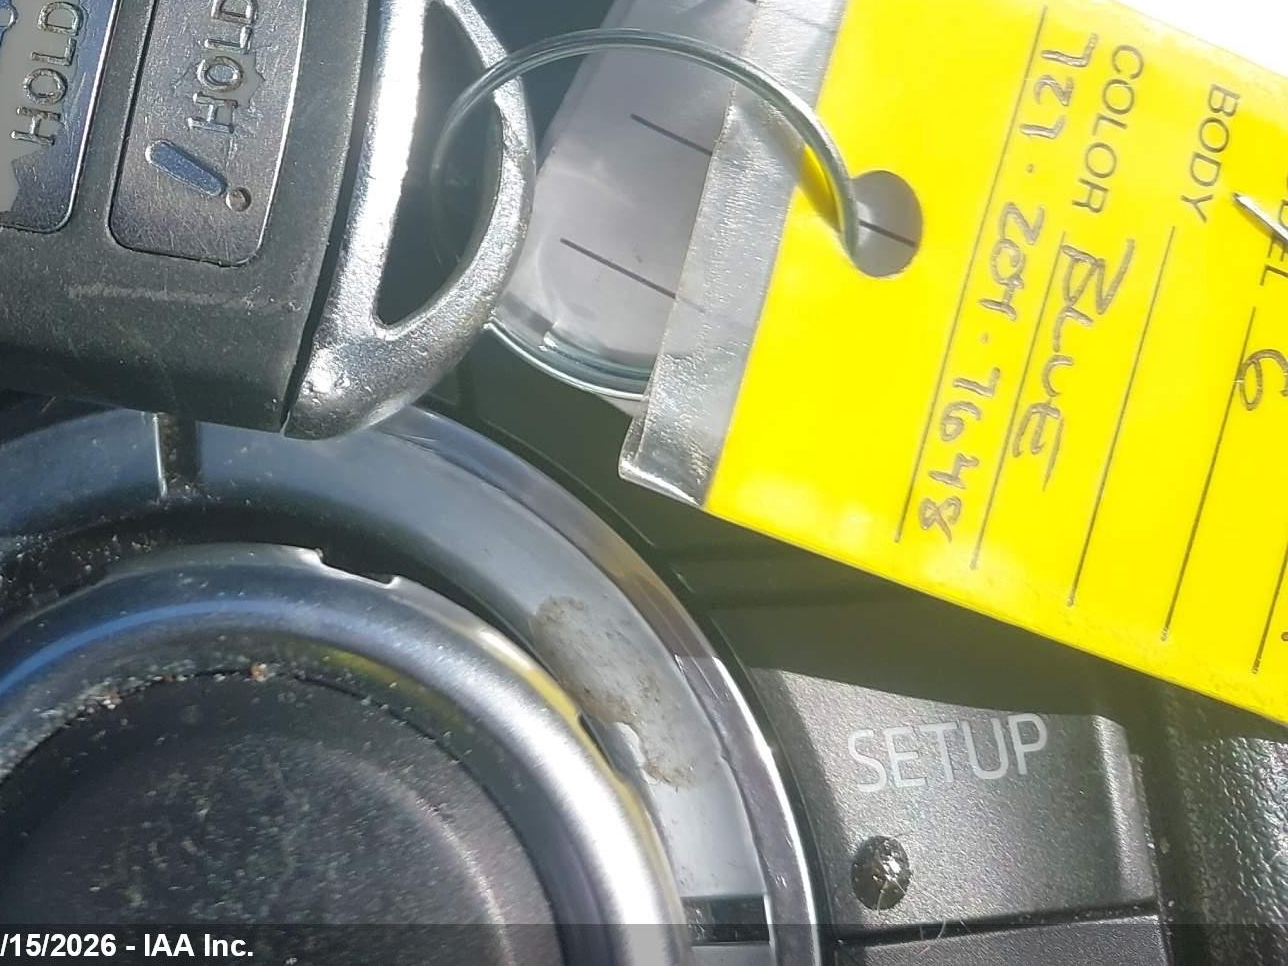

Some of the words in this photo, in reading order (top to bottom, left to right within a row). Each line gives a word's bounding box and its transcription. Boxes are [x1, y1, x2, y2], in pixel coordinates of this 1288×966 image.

[11, 0, 86, 146] HOLD
[1071, 44, 1144, 213] COLOR
[1180, 84, 1241, 223] BODY
[847, 712, 1048, 793] SETUP
